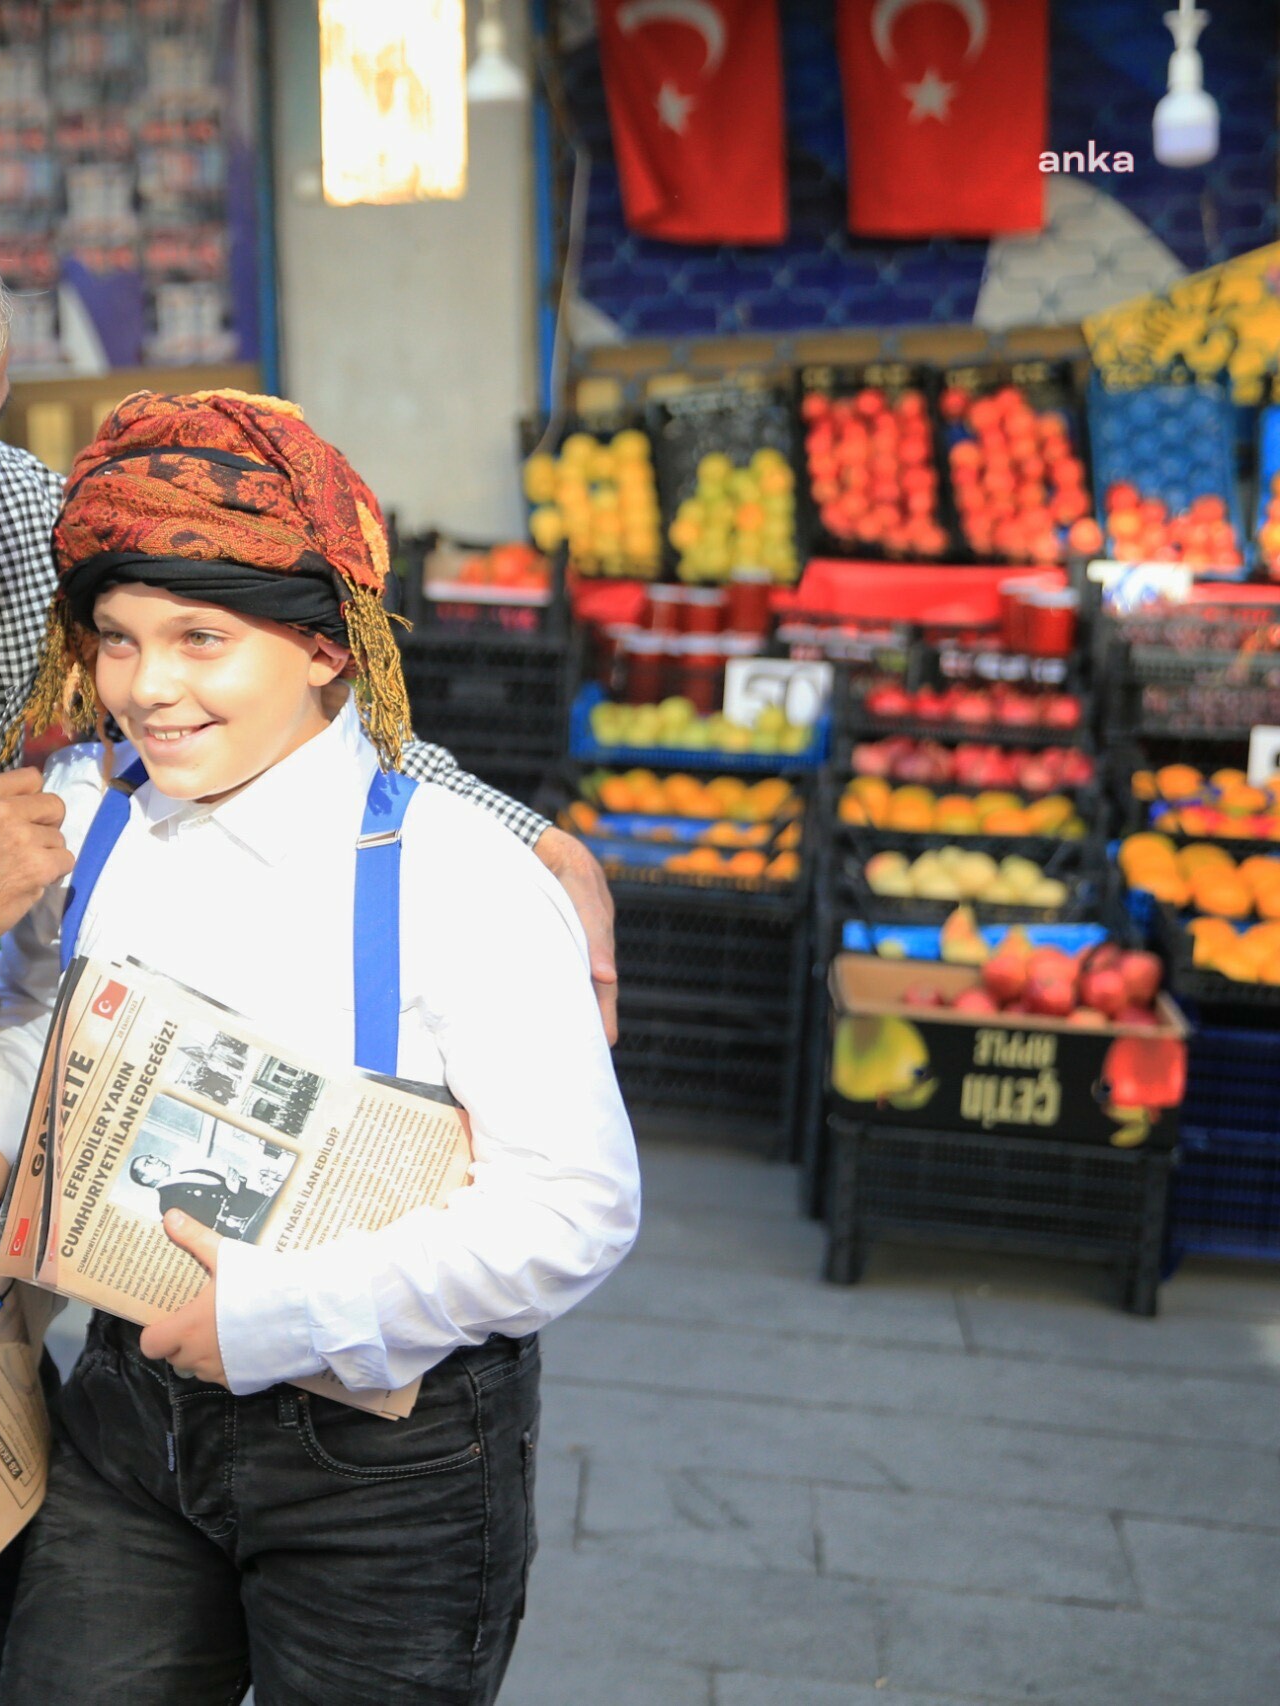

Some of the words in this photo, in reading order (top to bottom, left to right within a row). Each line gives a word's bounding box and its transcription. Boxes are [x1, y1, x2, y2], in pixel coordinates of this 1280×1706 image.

[61, 1146, 120, 1257] CUMHURİYETİ
[109, 1106, 138, 1145] İLAN
[63, 1116, 110, 1199] EFENDİLER
[102, 1062, 134, 1112] YARIN
[285, 1201, 306, 1232] NASIL
[302, 1171, 320, 1198] İLAN
[314, 1127, 339, 1170] EDİLDİ?
[74, 1227, 102, 1273] CUMHURİYET
[95, 1203, 112, 1228] NEDİR?
[8, 1459, 21, 1475] 28
